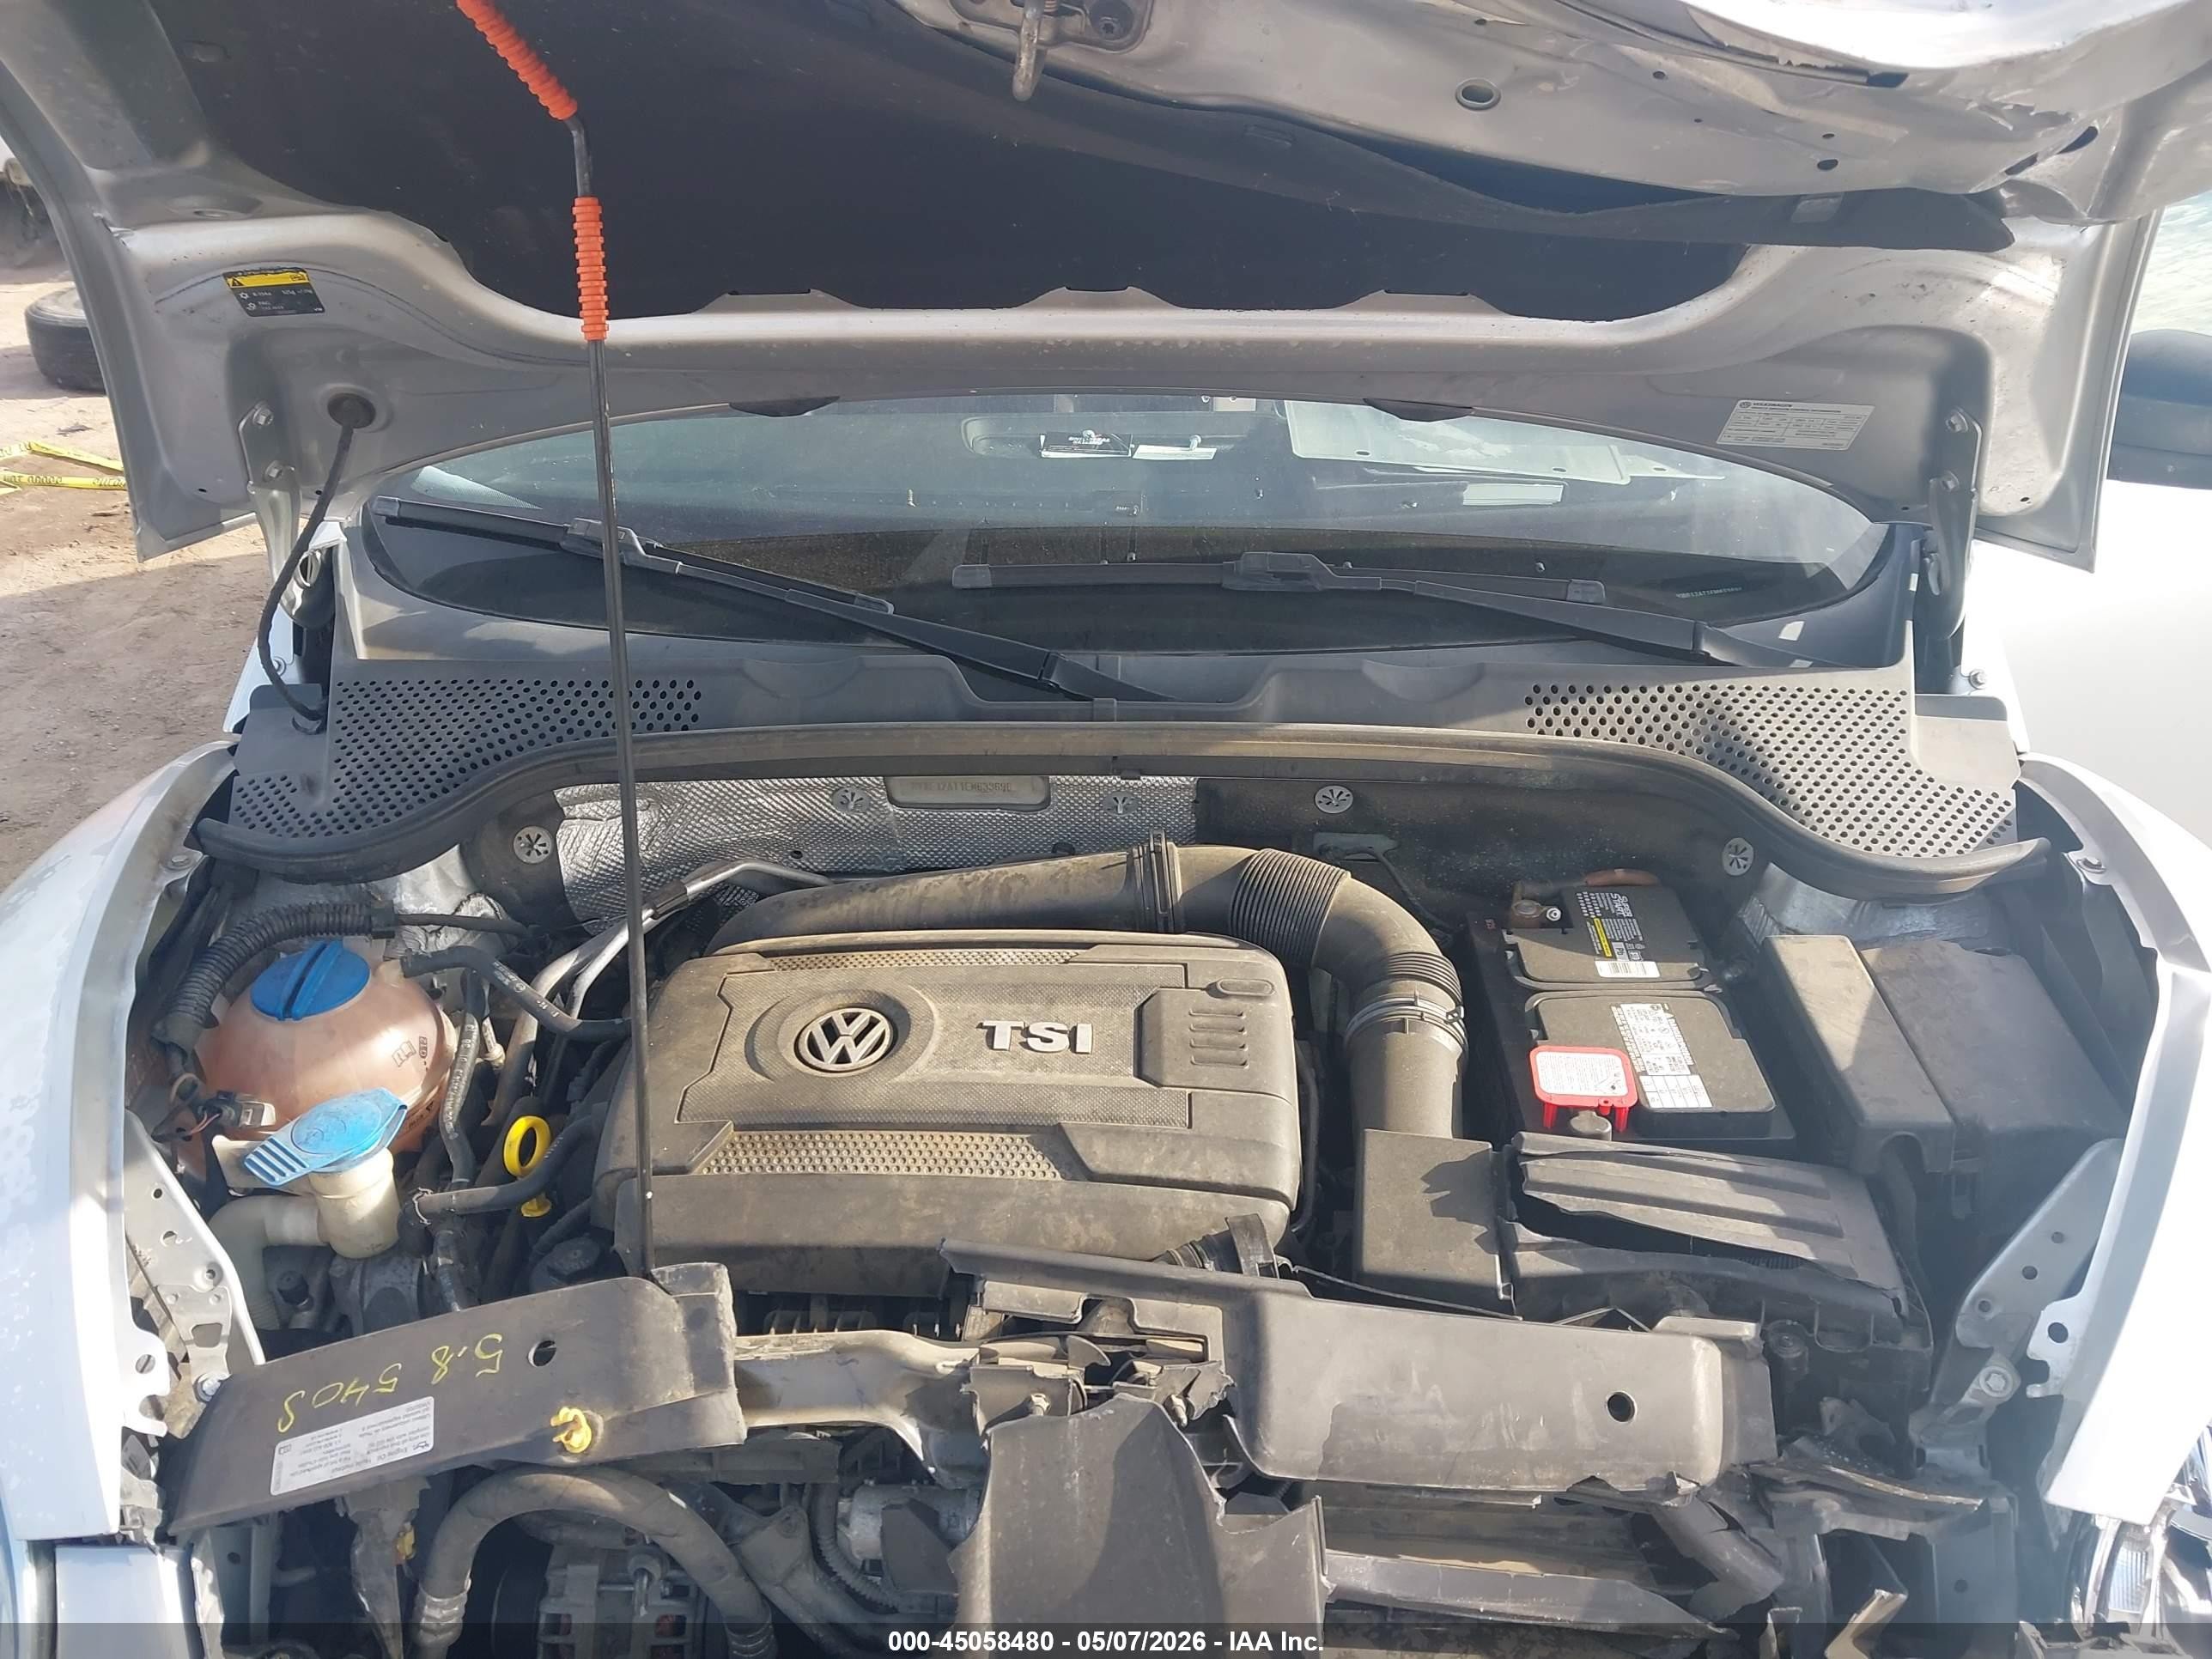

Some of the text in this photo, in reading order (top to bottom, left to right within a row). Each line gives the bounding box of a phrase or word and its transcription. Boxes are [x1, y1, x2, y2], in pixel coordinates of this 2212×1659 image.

[1610, 893, 1626, 917] START
[1620, 896, 1633, 917] SUPER
[982, 1019, 1093, 1054] TSI
